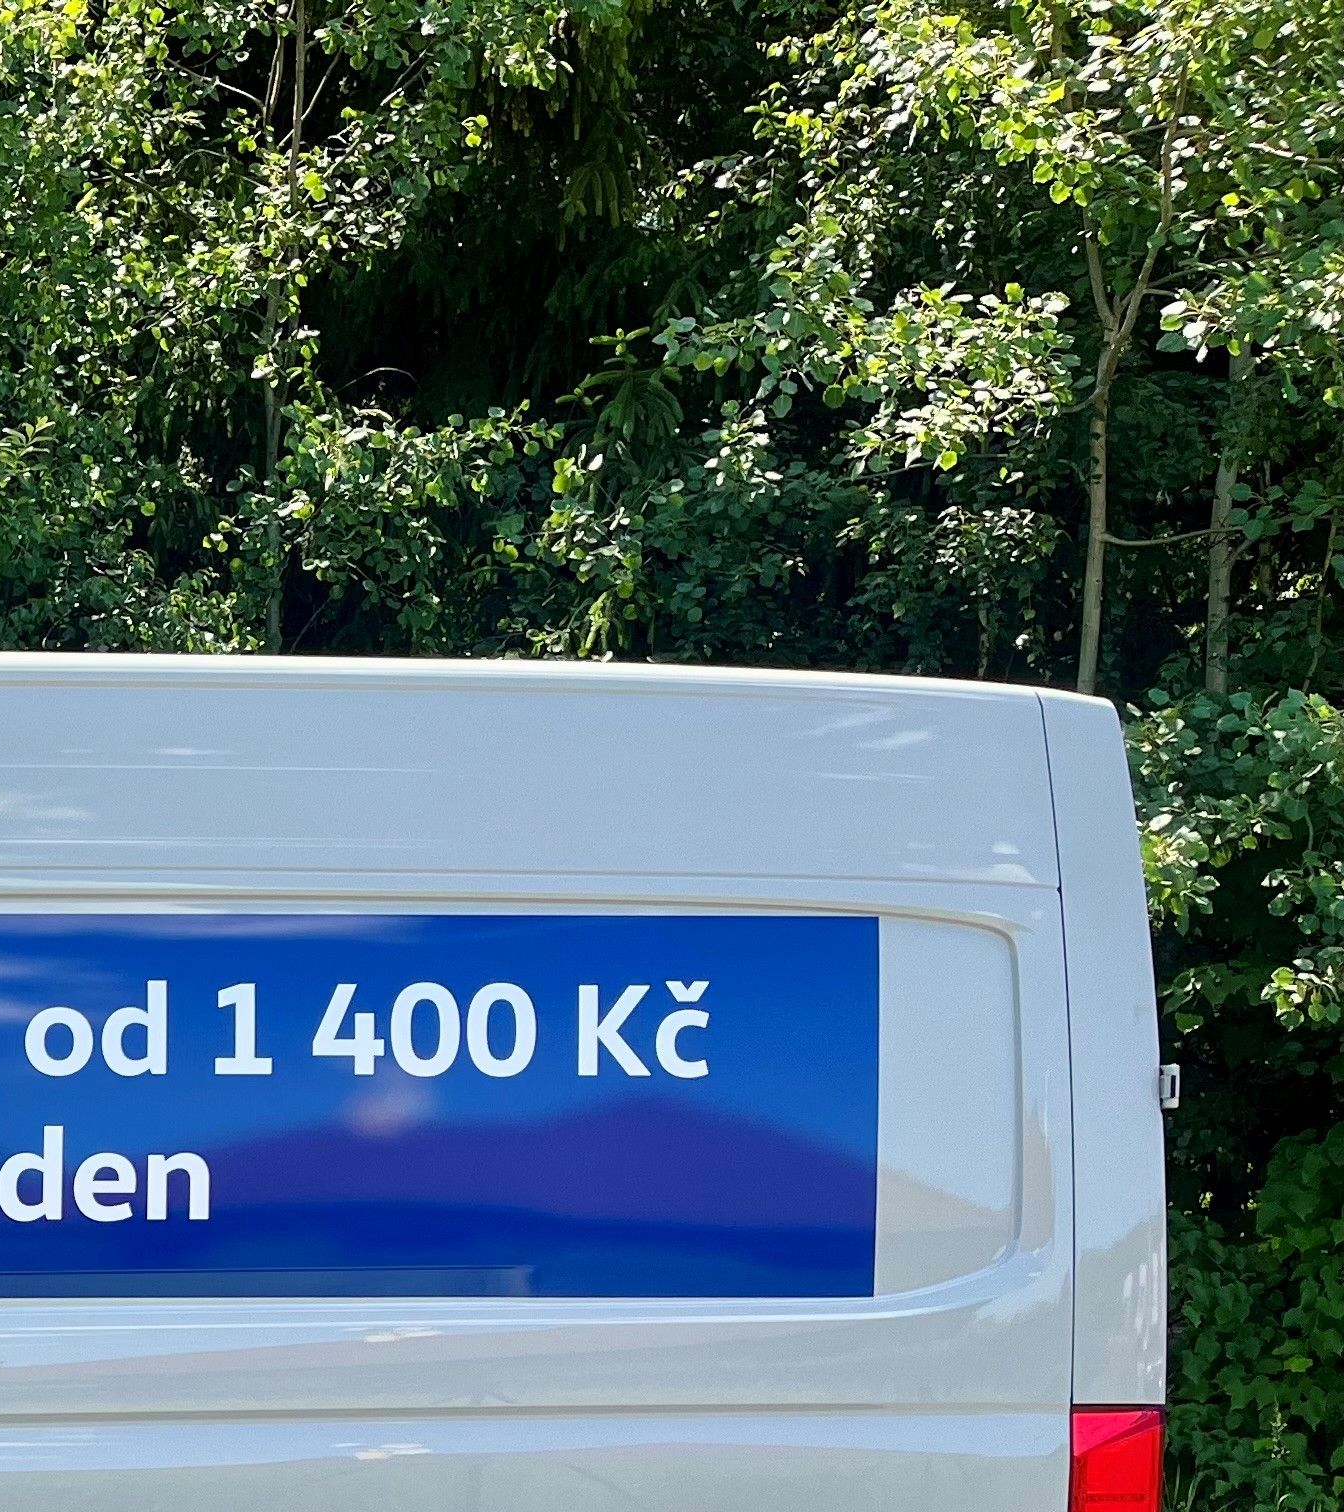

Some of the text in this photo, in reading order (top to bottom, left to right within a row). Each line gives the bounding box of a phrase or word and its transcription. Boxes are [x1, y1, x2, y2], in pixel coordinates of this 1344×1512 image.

[24, 980, 167, 1077] od
[214, 983, 272, 1076] 1
[311, 981, 537, 1078] 400
[577, 980, 710, 1079] Kč
